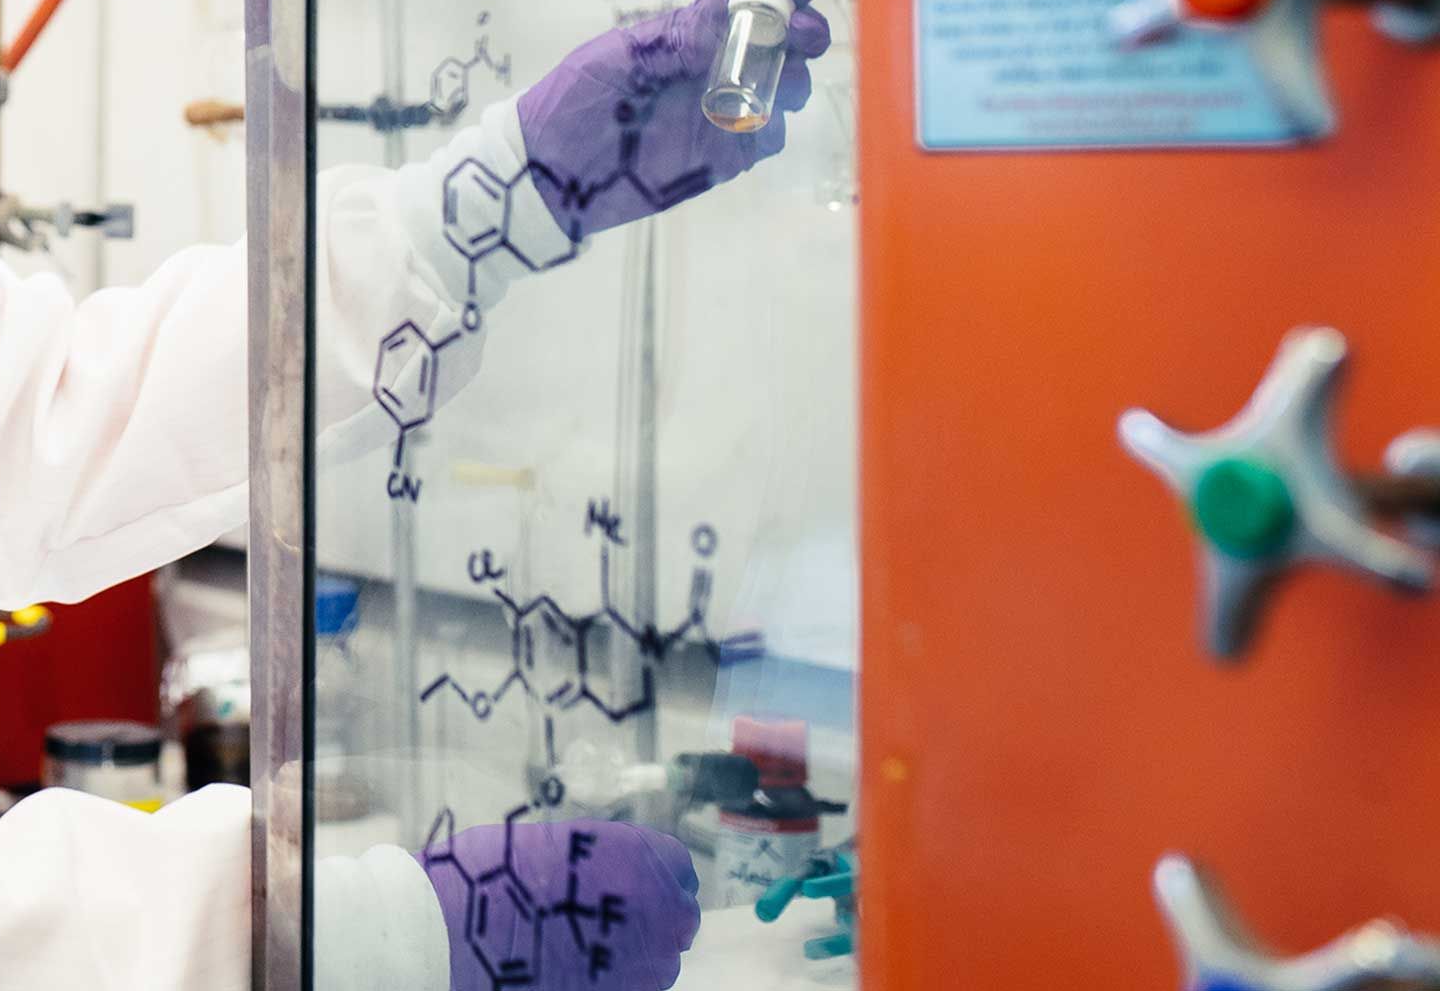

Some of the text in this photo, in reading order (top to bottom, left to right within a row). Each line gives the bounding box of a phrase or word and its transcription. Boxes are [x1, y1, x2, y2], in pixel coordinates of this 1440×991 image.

[462, 302, 482, 332] O
[387, 470, 422, 503] CN
[690, 524, 718, 558] O
[471, 691, 492, 719] O
[542, 776, 566, 806] O
[569, 830, 597, 865] F
[601, 893, 626, 936] F
[587, 942, 612, 982] F
